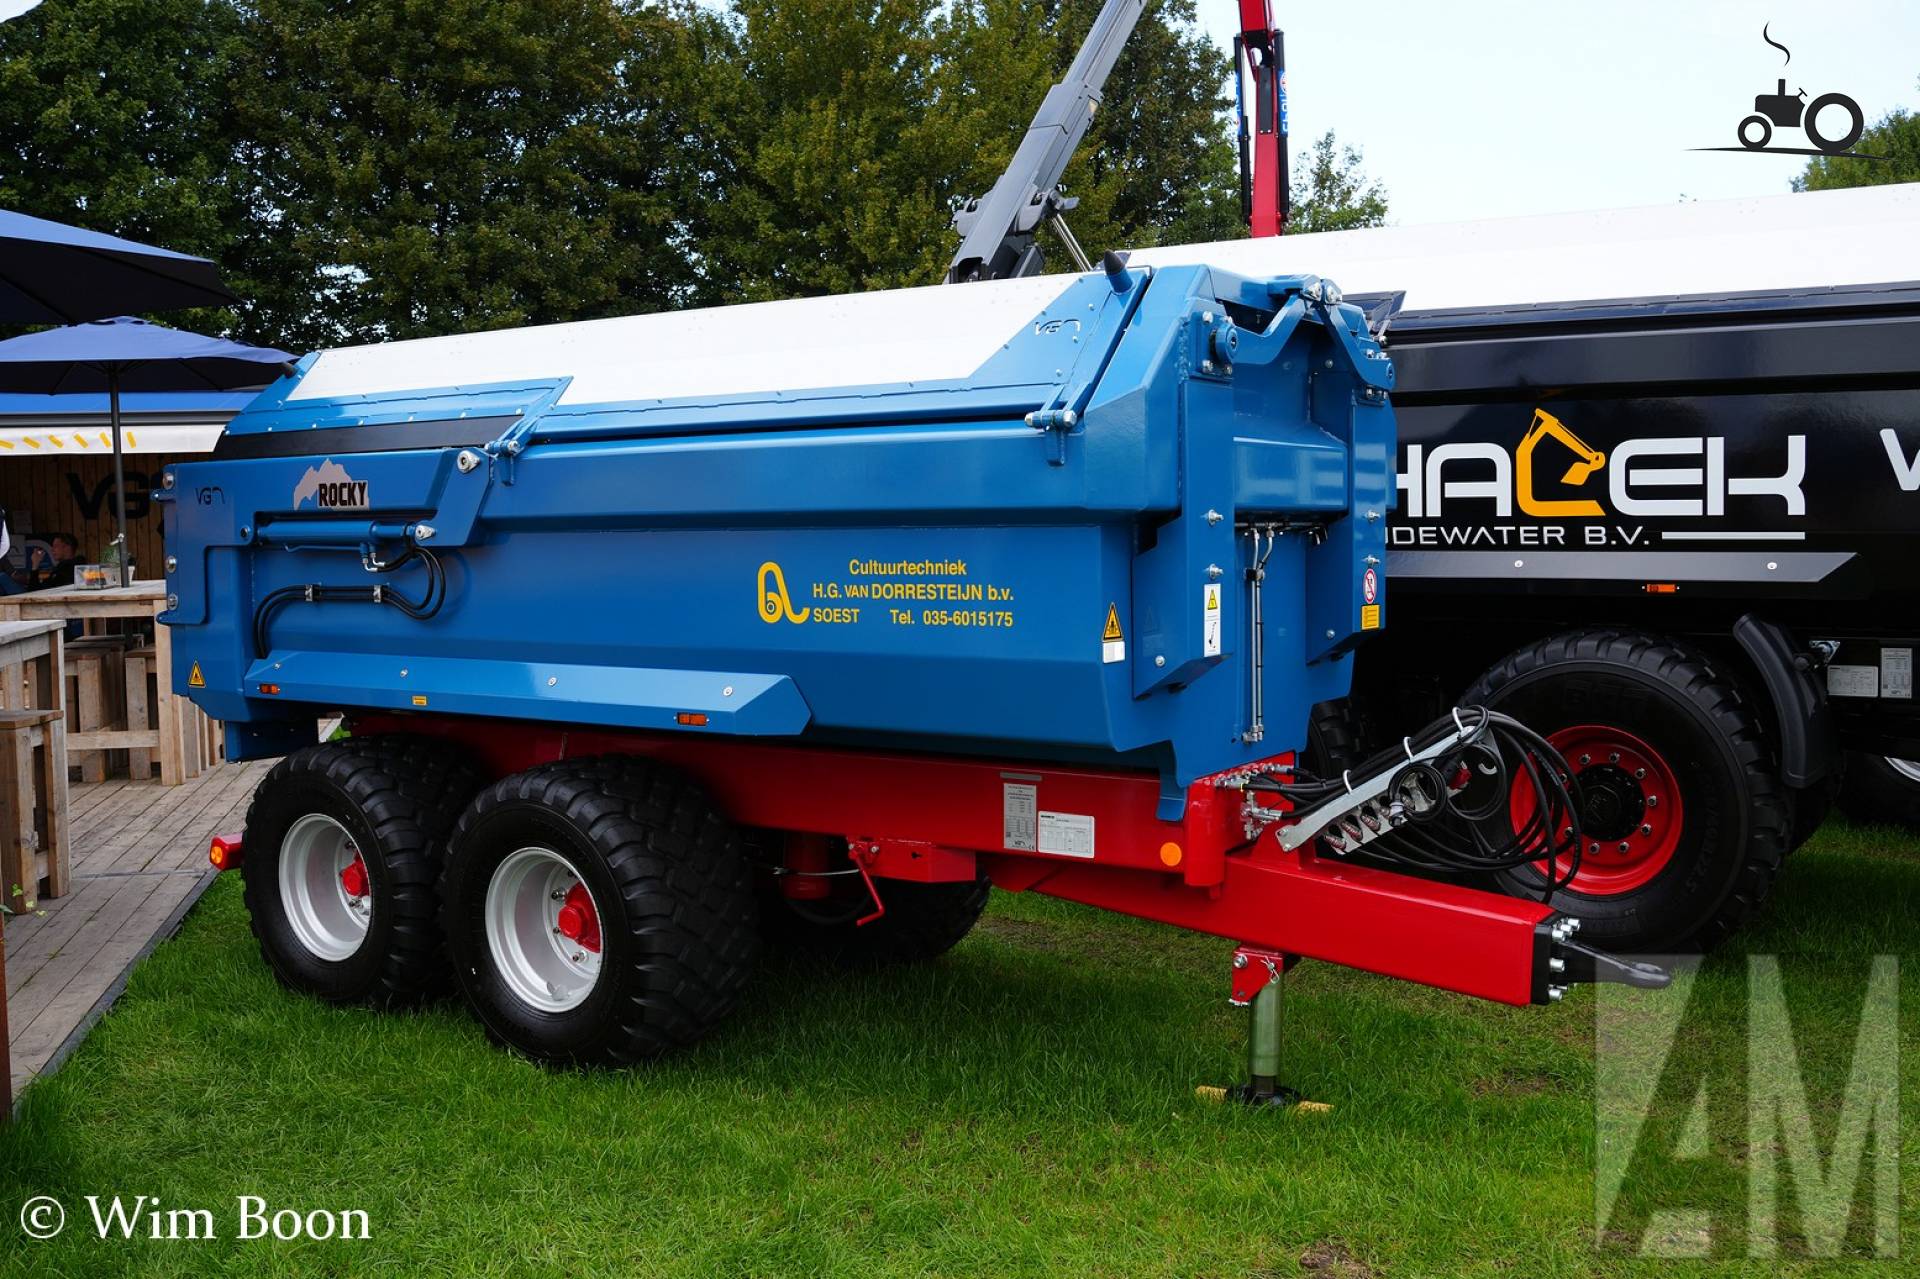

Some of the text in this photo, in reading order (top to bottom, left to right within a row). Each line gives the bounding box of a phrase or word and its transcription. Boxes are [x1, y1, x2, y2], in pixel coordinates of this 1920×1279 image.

[318, 482, 367, 507] ROCKY
[1385, 526, 1650, 545] DEWATER B.V.
[849, 559, 967, 575] Cultuurtechniek
[813, 583, 1014, 600] H.G. VAN DORRESTEIJN b.v.
[813, 608, 1013, 627] SOEST Tel. 035-6015175
